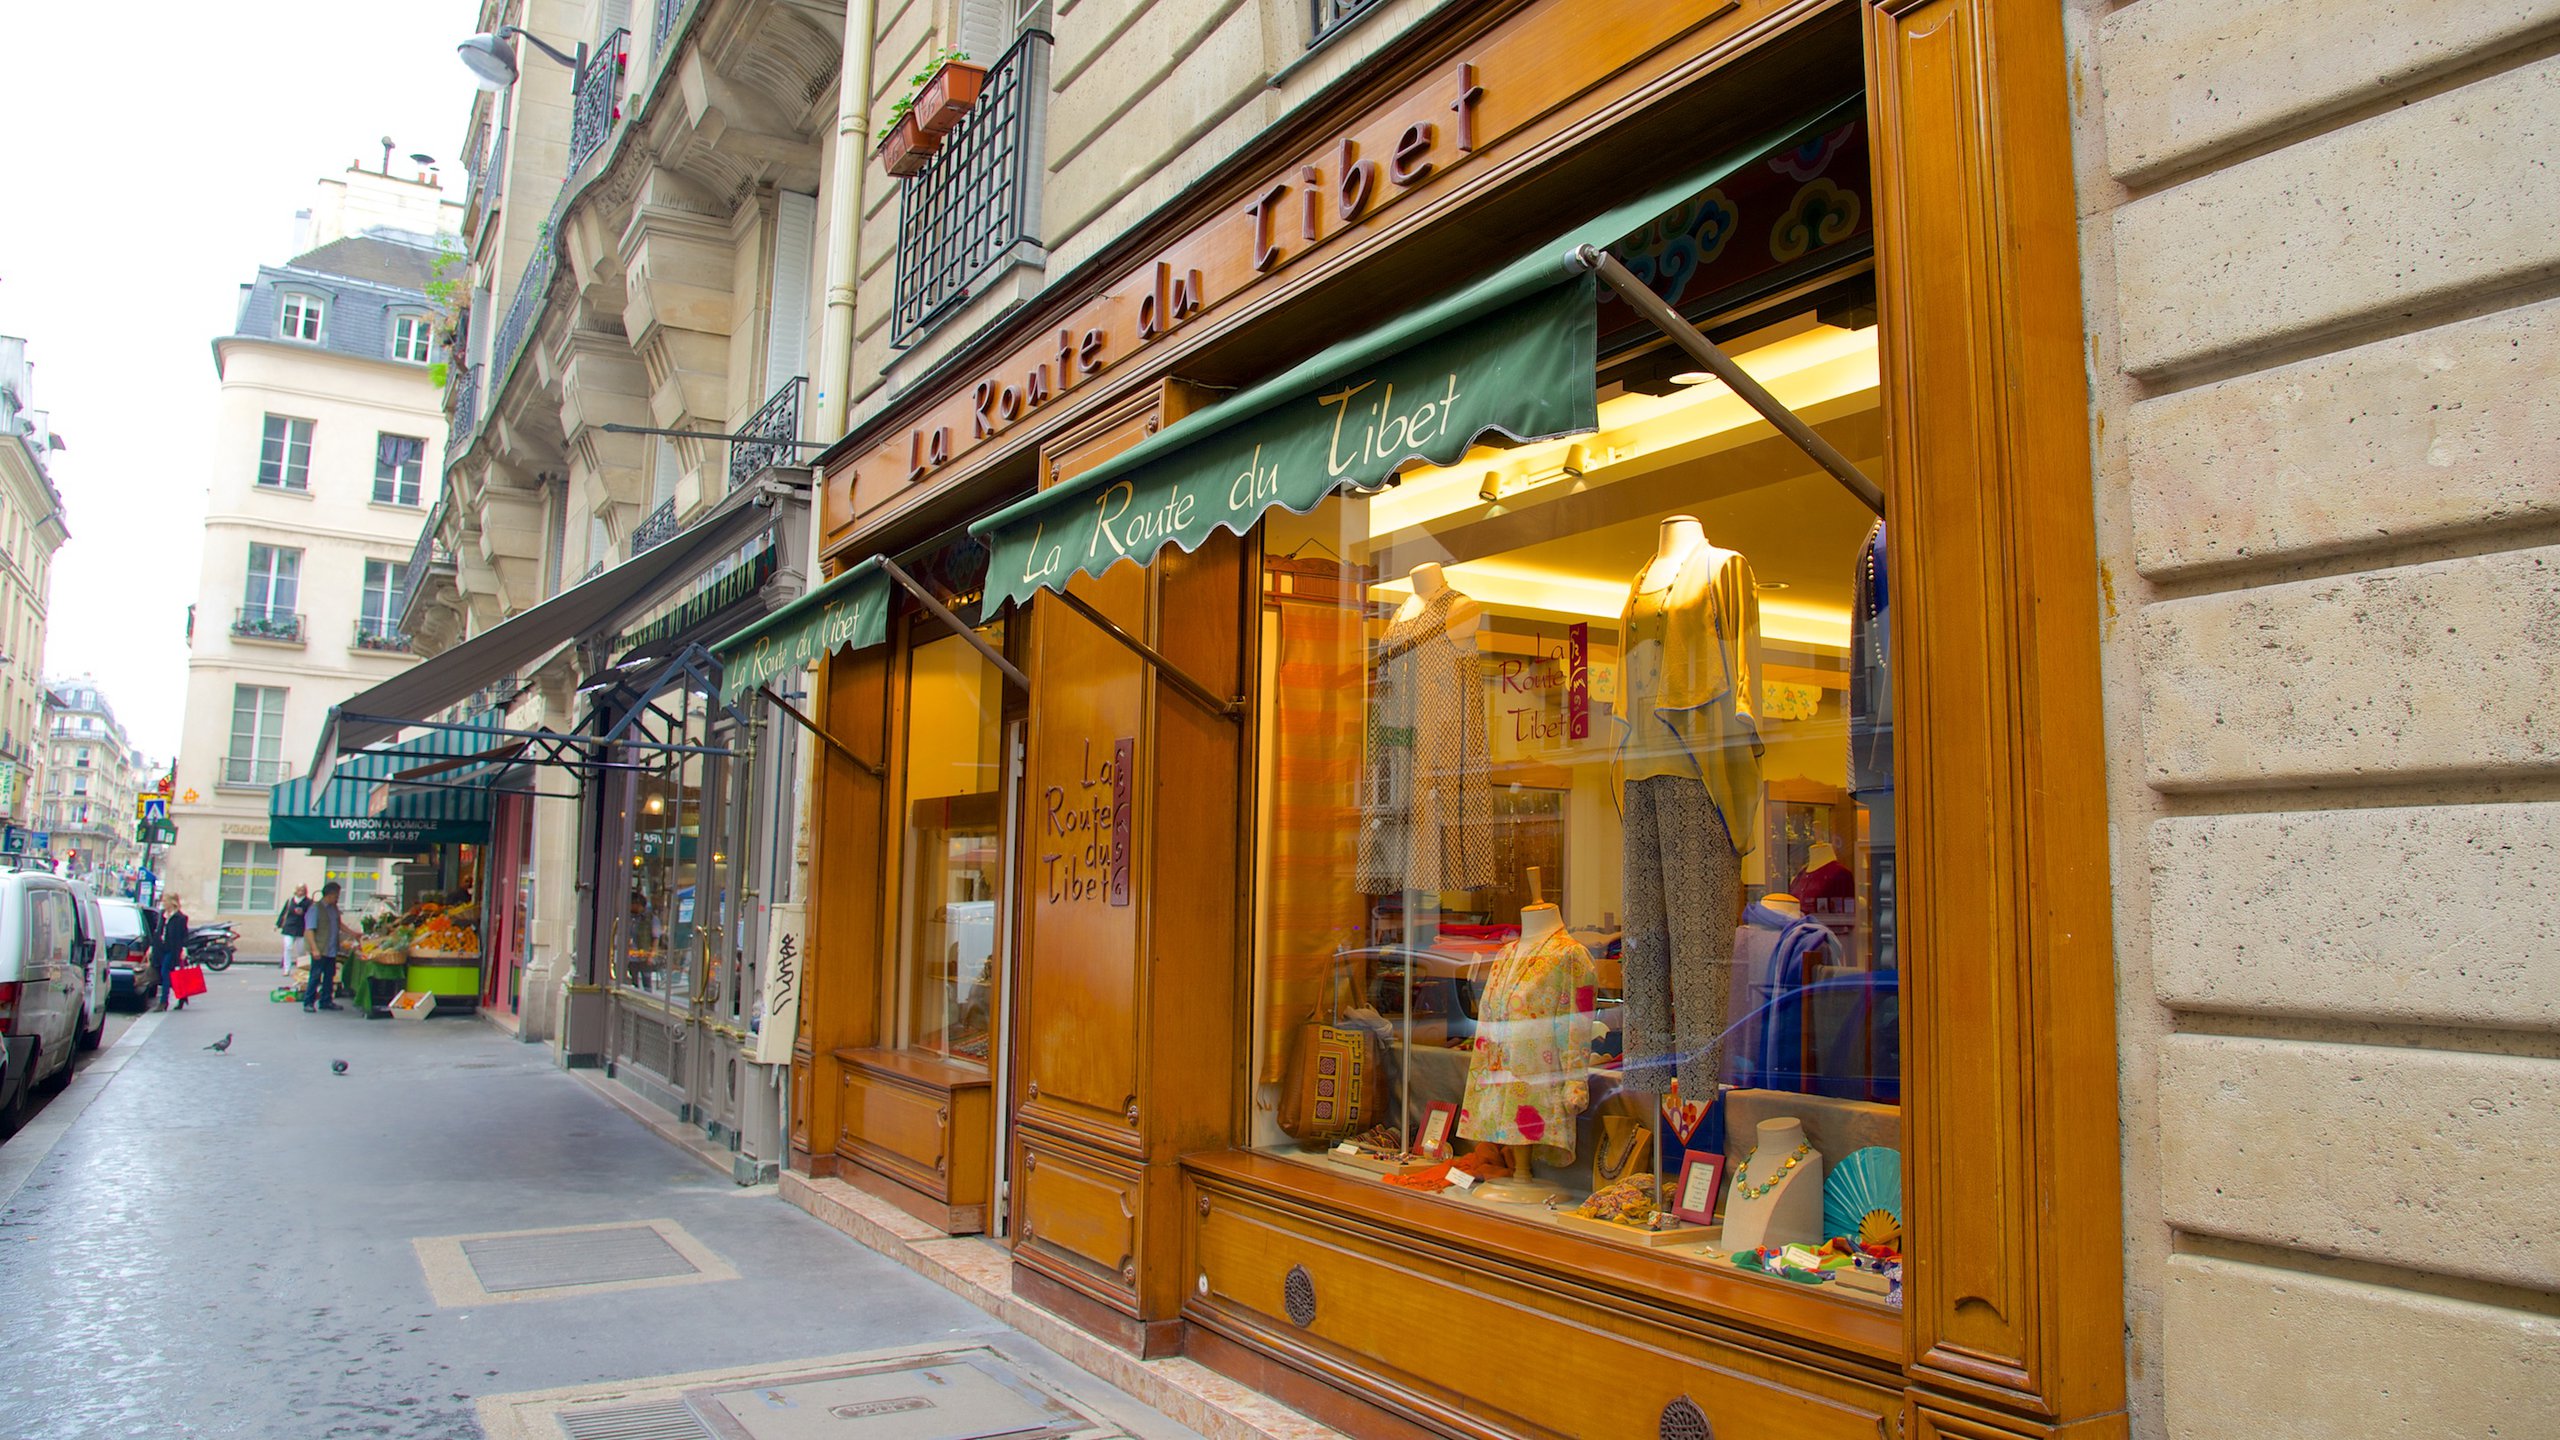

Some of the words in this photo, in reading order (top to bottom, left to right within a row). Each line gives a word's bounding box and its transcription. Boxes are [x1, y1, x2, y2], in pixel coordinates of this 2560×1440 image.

[906, 425, 949, 482] La
[972, 327, 1105, 440] Route
[1136, 260, 1203, 340] du
[1243, 62, 1485, 273] Tibet
[1022, 521, 1062, 584] La
[1088, 479, 1196, 558] Route
[1228, 442, 1279, 512] du
[1316, 372, 1462, 478] Tibet
[731, 651, 747, 690] La
[752, 635, 788, 682] Route
[795, 626, 812, 660] du
[821, 600, 860, 649] Tibet
[1534, 632, 1565, 665] La
[1498, 659, 1567, 695] Route
[1507, 707, 1568, 742] Tibet
[1080, 737, 1113, 788] La
[330, 818, 382, 830] LIVRAISON
[393, 820, 438, 831] DOMICILE
[348, 830, 421, 842] 01.43.54.49.87
[1045, 784, 1112, 840] Route
[1085, 824, 1111, 870] du
[1042, 852, 1110, 905] Tibet
